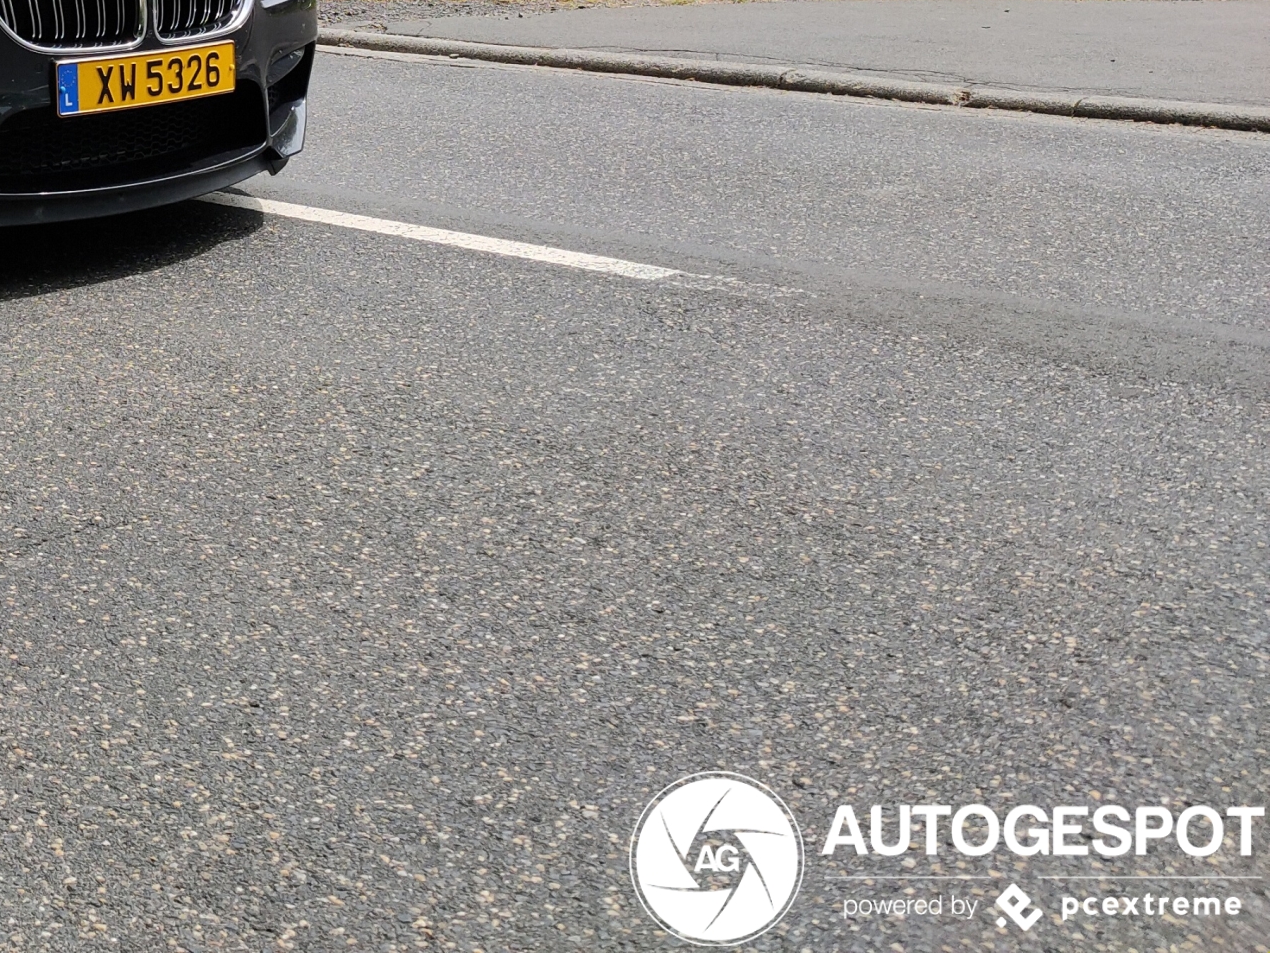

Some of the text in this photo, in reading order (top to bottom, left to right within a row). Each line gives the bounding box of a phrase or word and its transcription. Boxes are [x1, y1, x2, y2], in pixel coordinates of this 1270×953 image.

[96, 51, 221, 105] XW 5326
[64, 93, 73, 107] L
